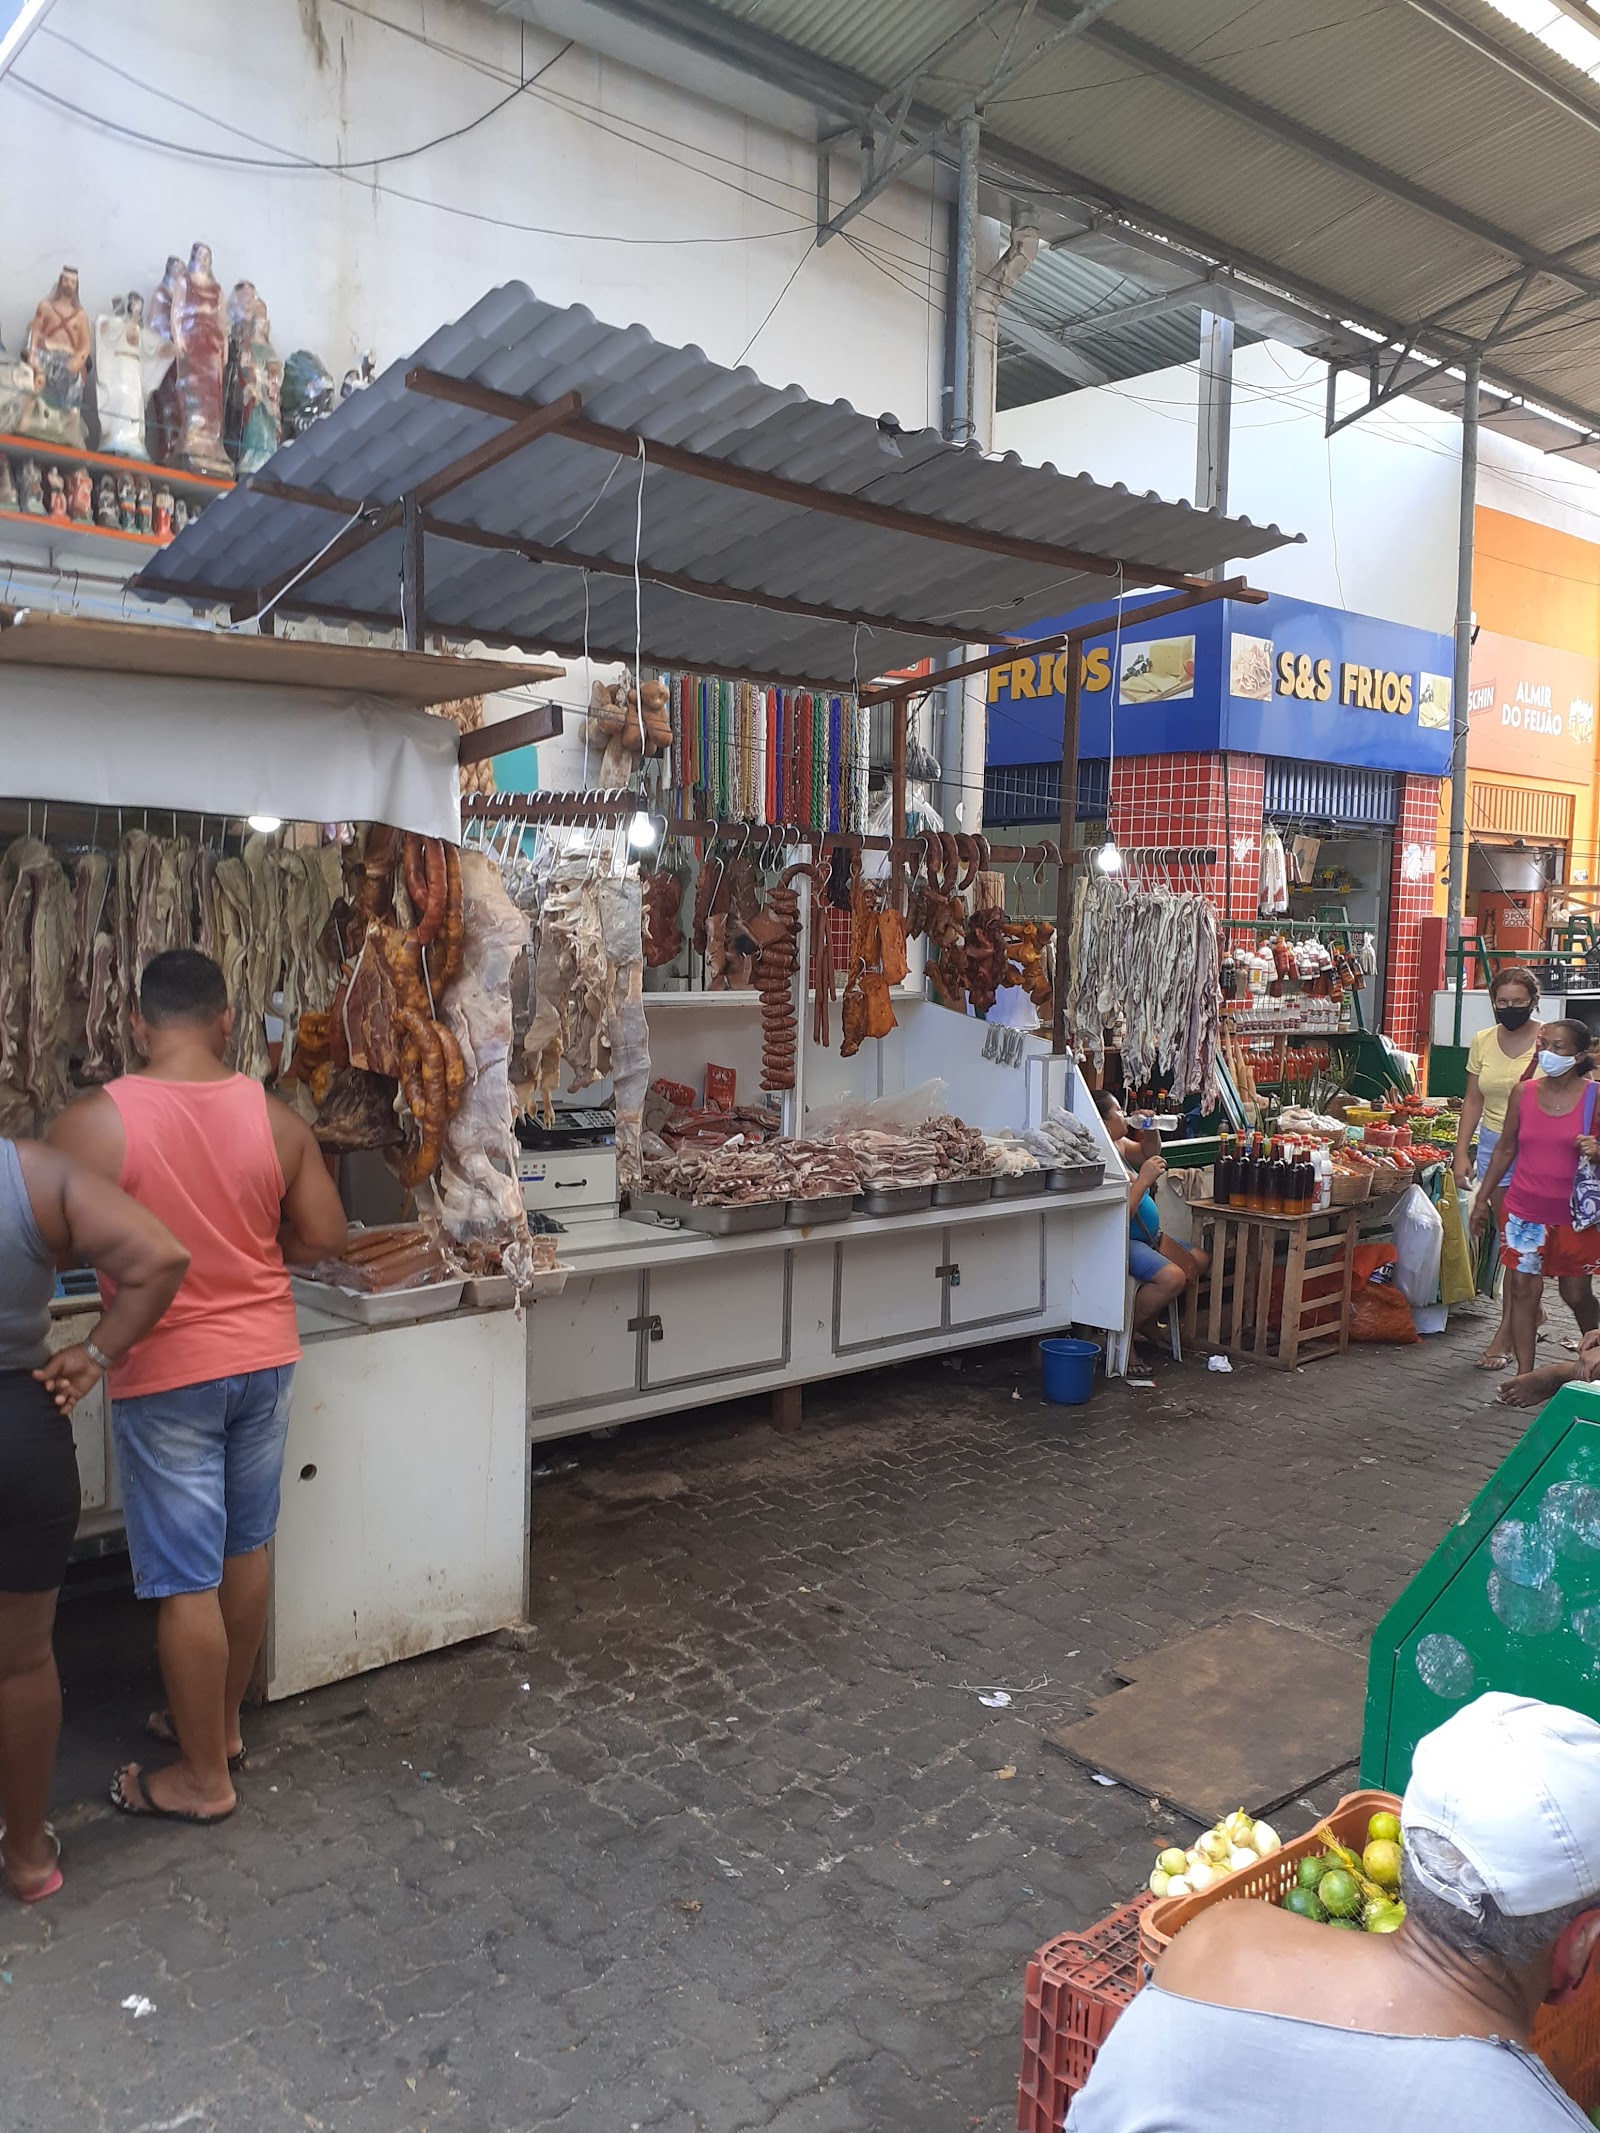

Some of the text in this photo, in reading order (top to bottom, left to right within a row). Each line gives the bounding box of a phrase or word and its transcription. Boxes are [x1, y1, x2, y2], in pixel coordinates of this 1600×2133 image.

[988, 648, 1112, 704] FRIOS
[1276, 651, 1413, 715] S&S FRIOS
[1515, 680, 1552, 708] ALMIR
[1501, 703, 1563, 736] DO FEIJÃO
